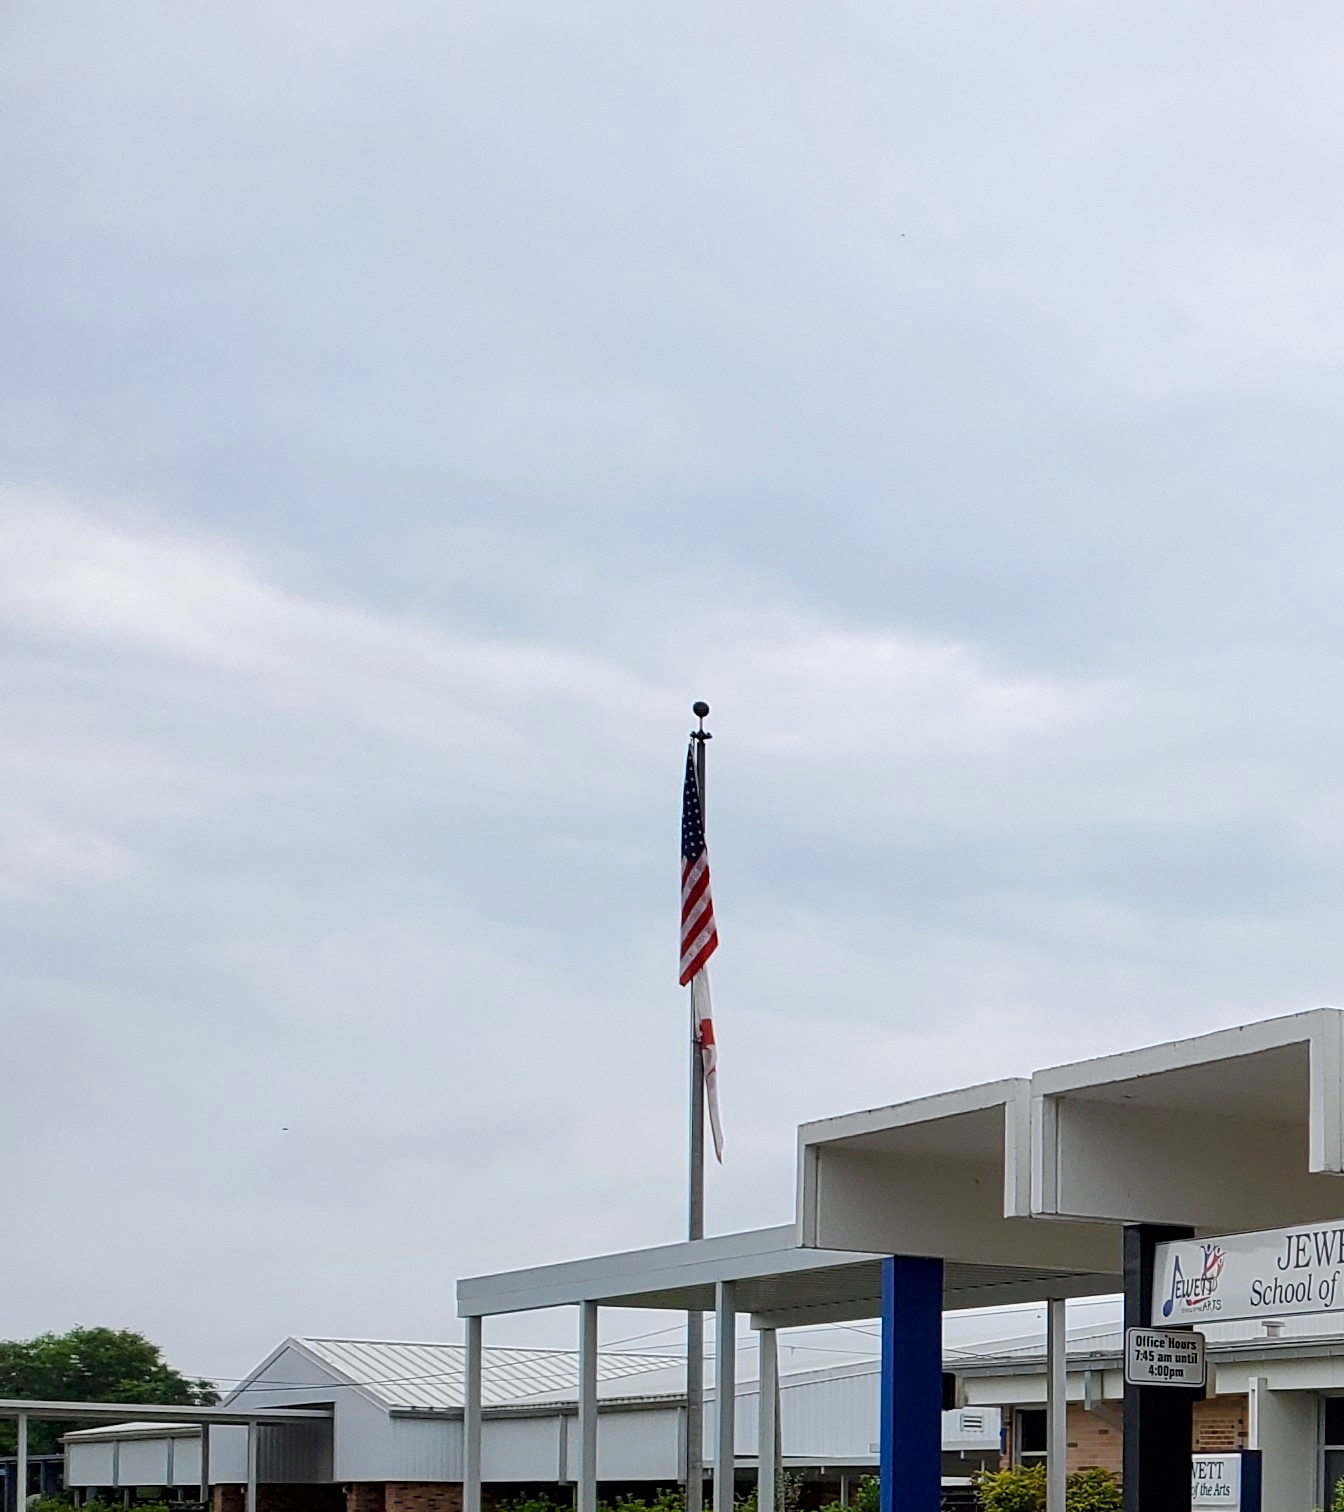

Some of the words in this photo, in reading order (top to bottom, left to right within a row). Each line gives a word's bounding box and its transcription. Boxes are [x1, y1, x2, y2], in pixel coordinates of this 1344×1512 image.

[1250, 1273, 1313, 1307] School
[1318, 1270, 1341, 1308] of
[1136, 1335, 1165, 1349] Office
[1168, 1336, 1197, 1350] Hours
[1134, 1349, 1155, 1362] 7:45
[1157, 1353, 1173, 1363] am
[1175, 1352, 1198, 1364] until
[1148, 1364, 1184, 1380] 4:00pm
[1200, 1482, 1213, 1496] the
[1213, 1482, 1231, 1497] Arts
